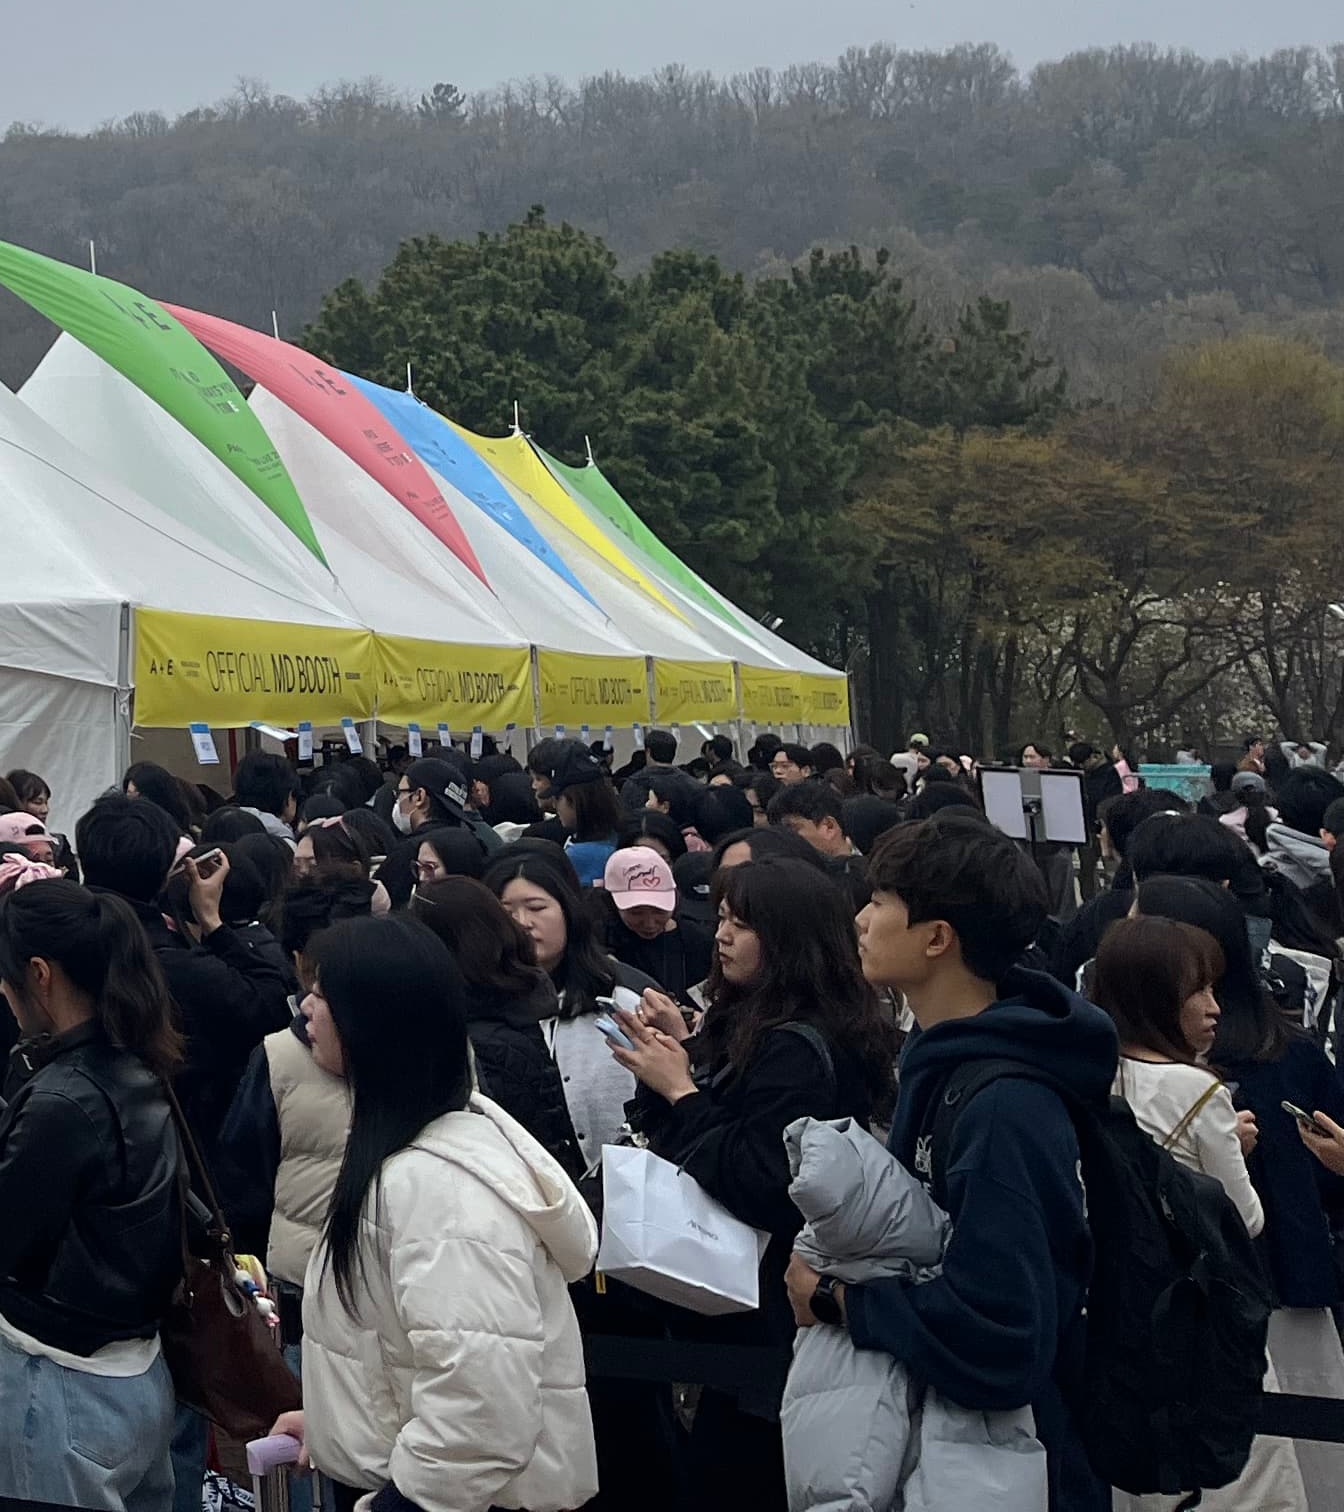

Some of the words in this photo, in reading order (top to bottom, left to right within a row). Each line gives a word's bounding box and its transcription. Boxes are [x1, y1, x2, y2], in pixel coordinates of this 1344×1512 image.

[150, 660, 158, 675] A
[167, 659, 174, 676] E
[207, 650, 270, 693] OFFICIAL
[271, 653, 296, 694] MD
[299, 655, 342, 695] BOOTH
